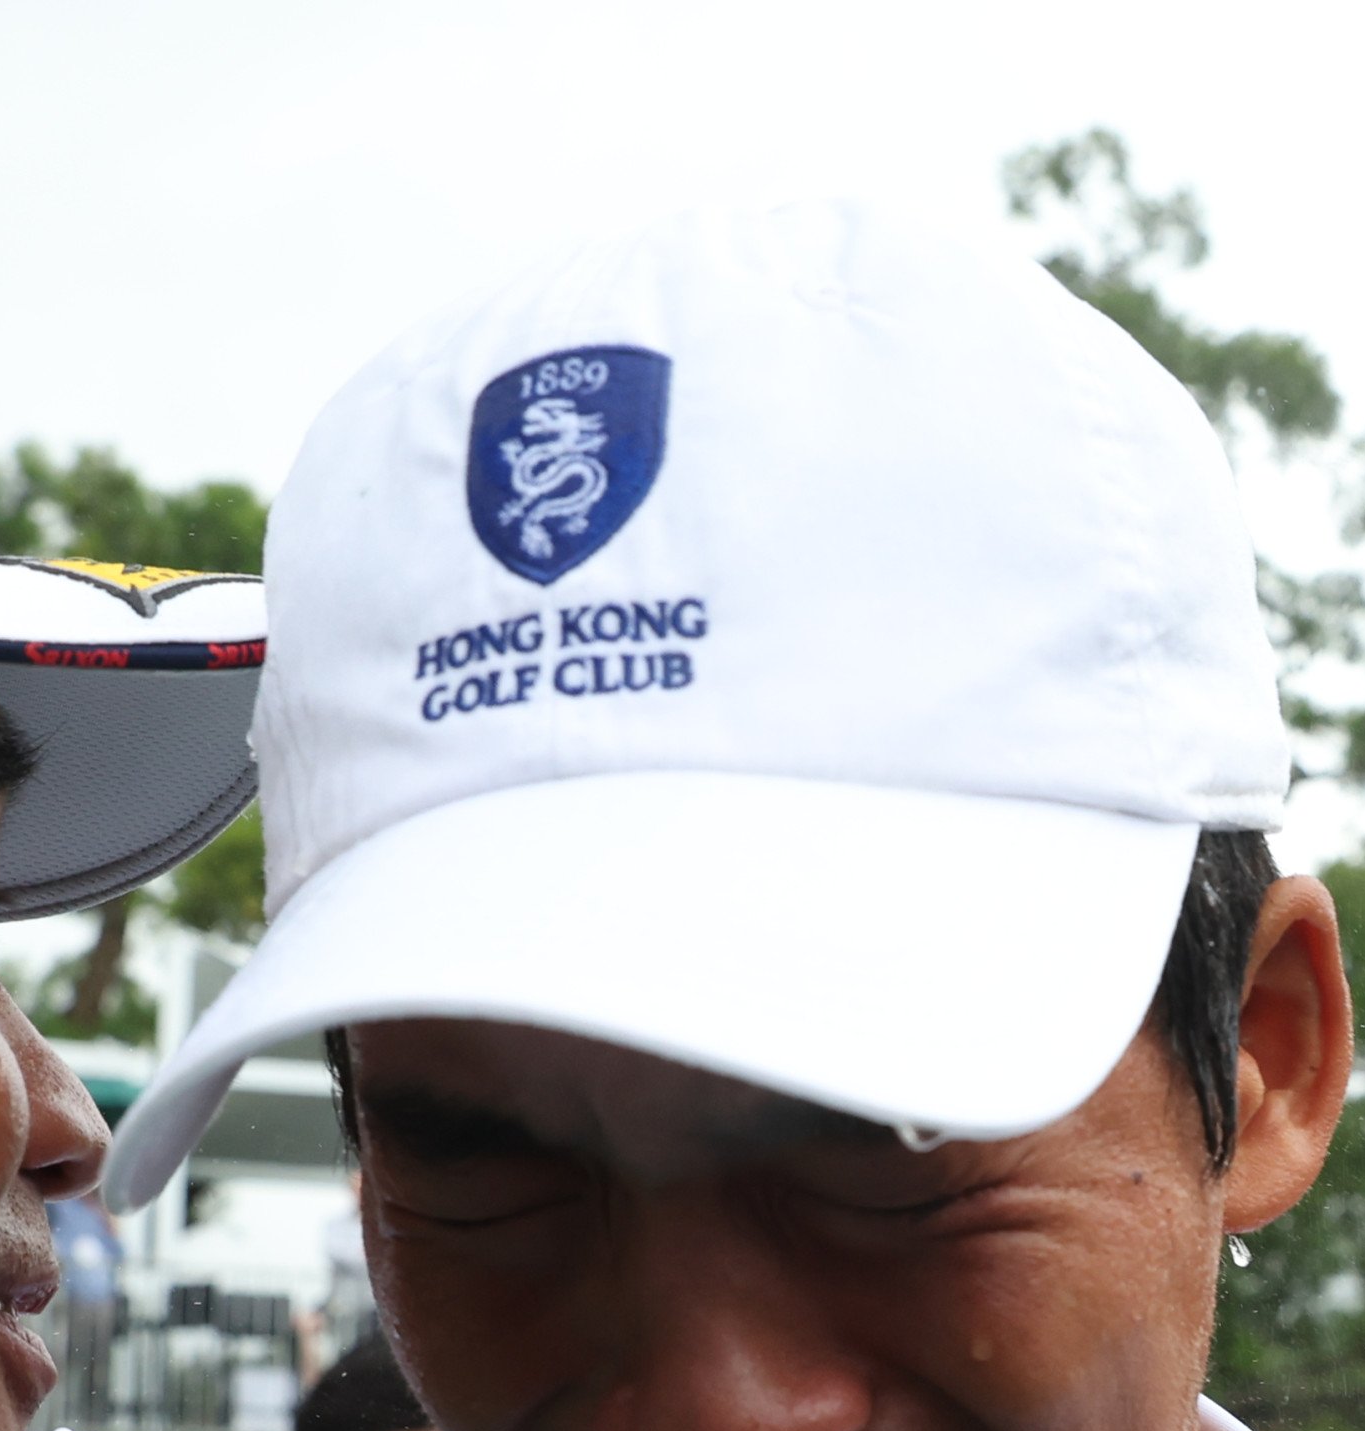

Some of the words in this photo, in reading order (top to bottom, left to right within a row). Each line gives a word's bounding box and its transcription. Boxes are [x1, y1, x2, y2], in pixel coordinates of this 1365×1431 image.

[518, 358, 609, 398] 1889
[25, 642, 130, 669] SRIXON
[415, 612, 544, 680] HONG
[558, 597, 709, 648] KONG
[421, 664, 541, 722] GOLF
[552, 651, 694, 698] CLUB
